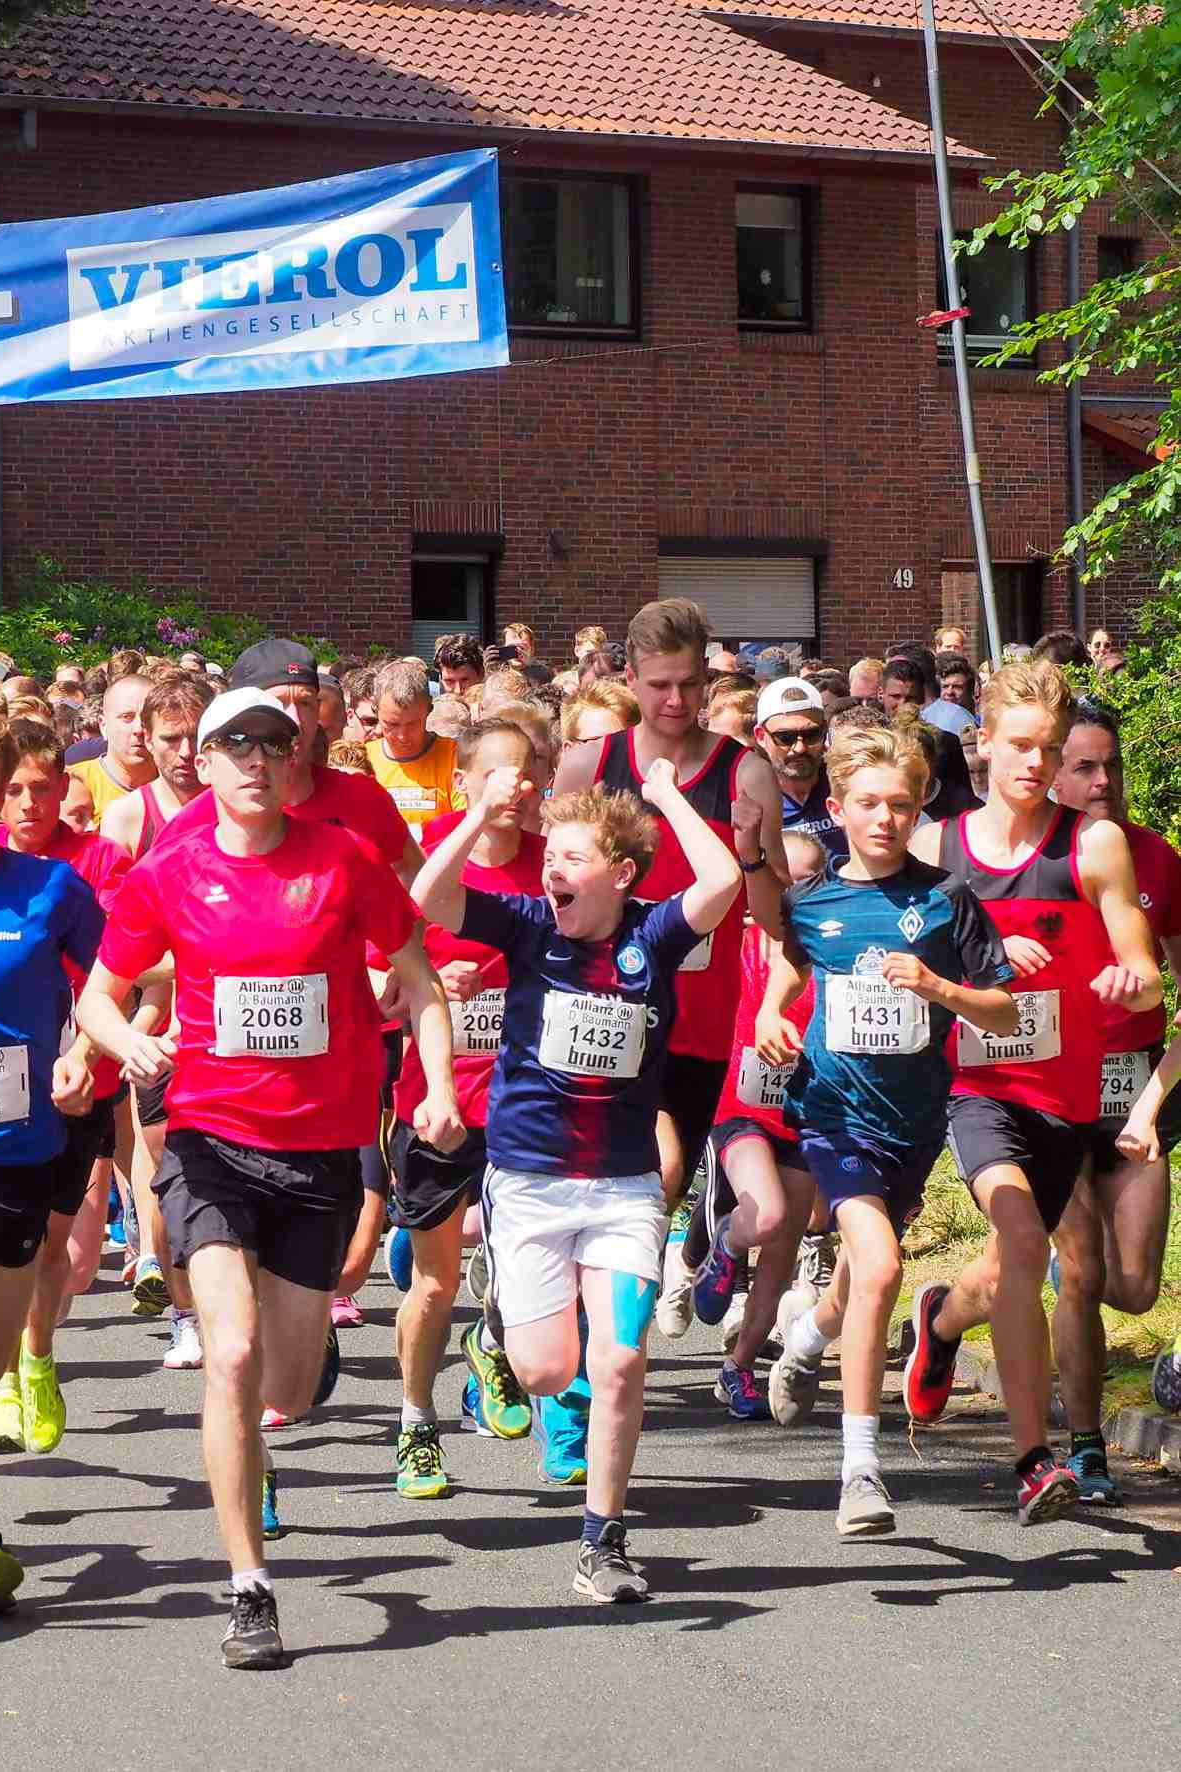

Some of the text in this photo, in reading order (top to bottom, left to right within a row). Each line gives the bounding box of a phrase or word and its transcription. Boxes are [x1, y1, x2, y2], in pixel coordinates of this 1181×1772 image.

[79, 228, 470, 326] VIEROL
[100, 303, 471, 350] AKTIENGESELLSCHAFT
[892, 568, 914, 588] 49
[239, 980, 285, 992] Allianz
[848, 980, 887, 992] Allianz
[253, 994, 305, 1005] Baumann
[474, 1002, 504, 1013] Baum
[571, 998, 614, 1016] Allianz
[858, 993, 907, 1005] Baumann
[242, 1006, 303, 1028] 2068
[463, 1014, 503, 1031] 206
[582, 1012, 631, 1030] Baumann
[849, 1005, 901, 1026] 1431
[246, 1030, 299, 1050] bruns
[570, 1024, 626, 1050] 1432
[852, 1026, 900, 1047] bruns
[568, 1045, 618, 1070] bruns
[986, 1041, 1034, 1059] bruns
[1100, 1077, 1135, 1095] 794
[760, 1089, 784, 1105] bru
